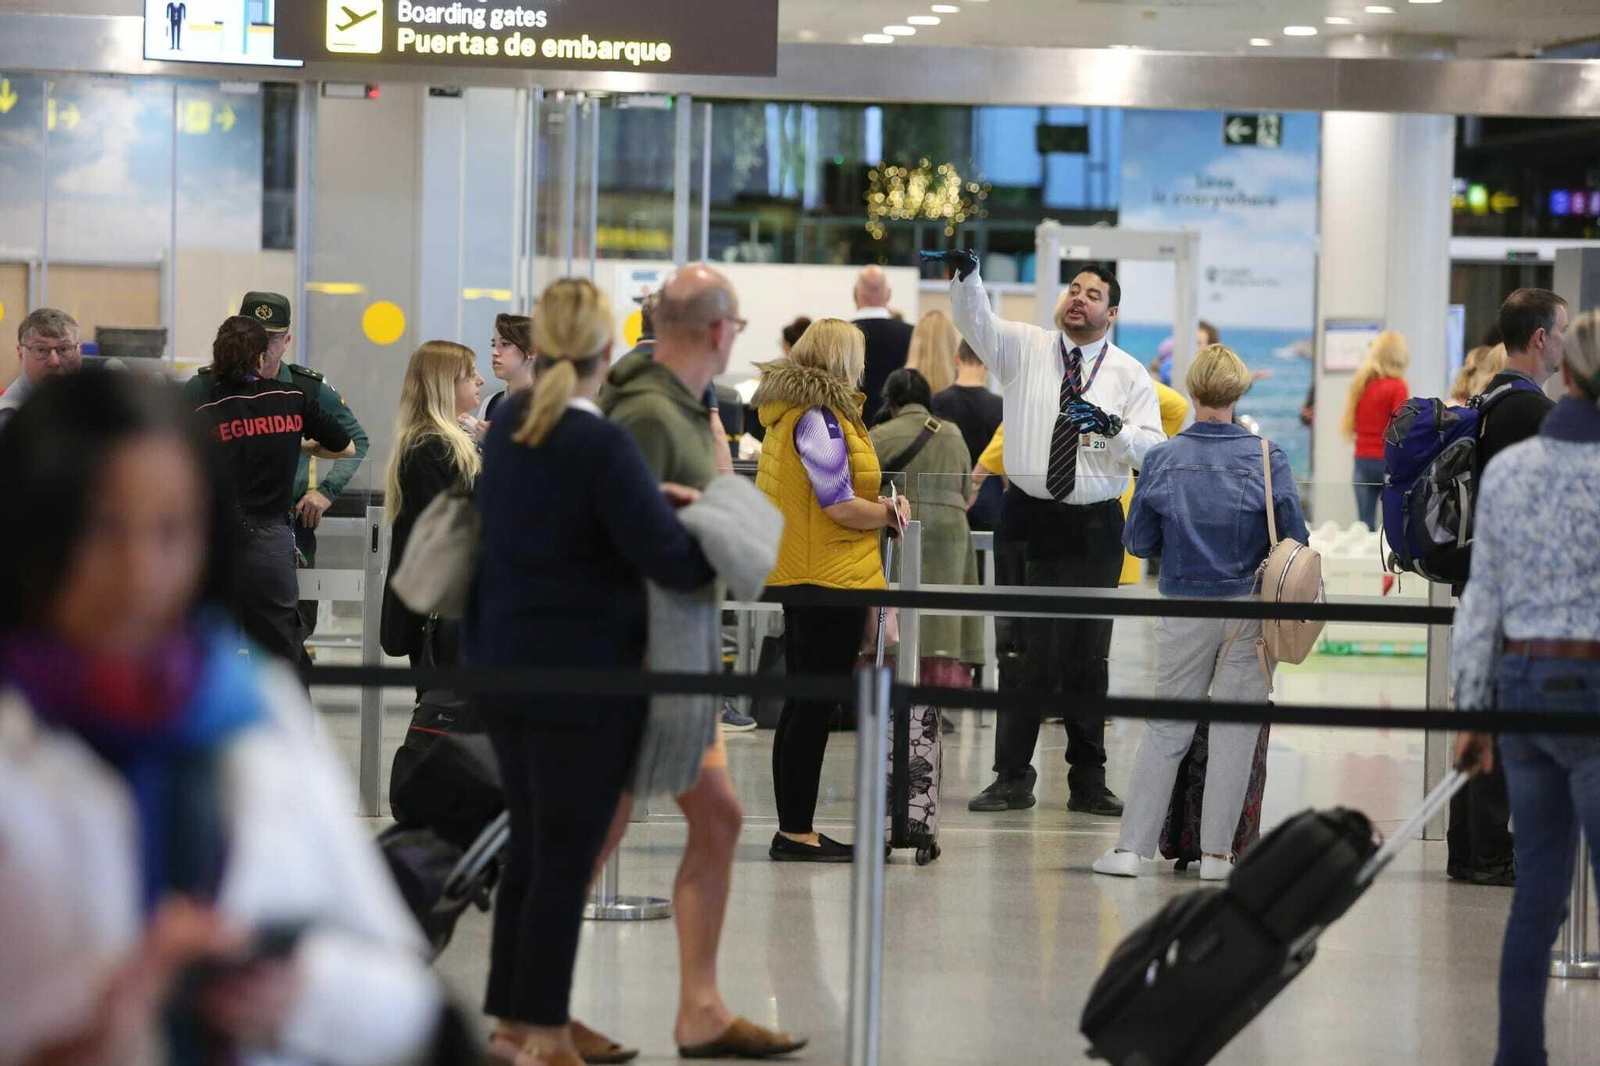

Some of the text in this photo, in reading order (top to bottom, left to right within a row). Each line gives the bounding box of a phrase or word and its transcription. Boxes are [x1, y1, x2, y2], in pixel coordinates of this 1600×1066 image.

[397, 0, 548, 30] Boarding gates
[397, 27, 672, 66] Puertas de embarque
[211, 414, 304, 442] EGURIDAD
[1093, 441, 1106, 449] 20
